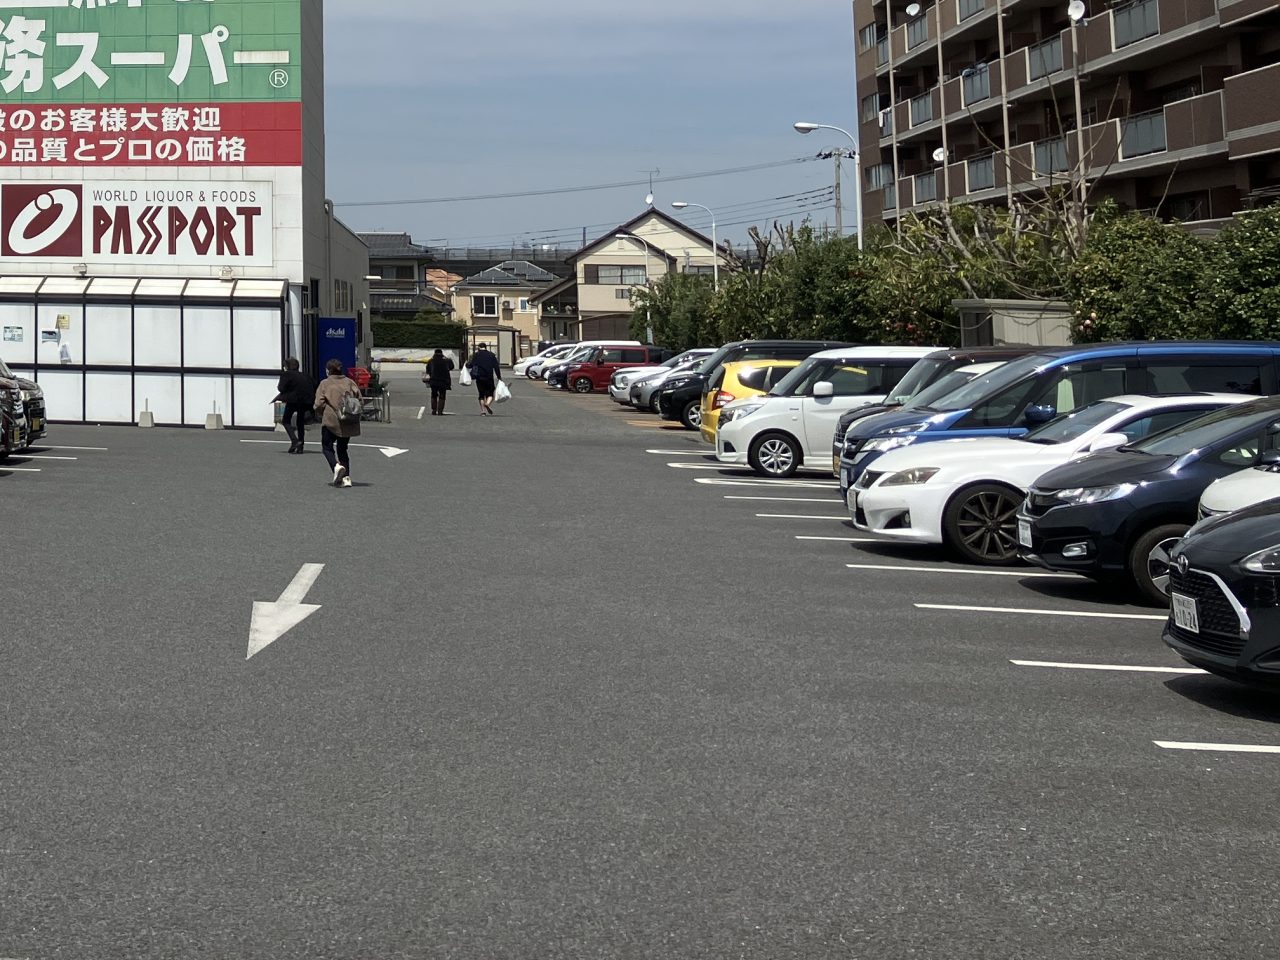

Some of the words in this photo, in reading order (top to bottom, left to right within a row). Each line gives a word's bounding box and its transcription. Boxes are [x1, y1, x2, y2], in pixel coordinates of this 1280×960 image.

[93, 190, 138, 201] WORLD
[145, 190, 194, 202] LIQUOR
[198, 191, 206, 202] &
[212, 191, 256, 202] FOODS
[92, 205, 262, 256] PASSPORT
